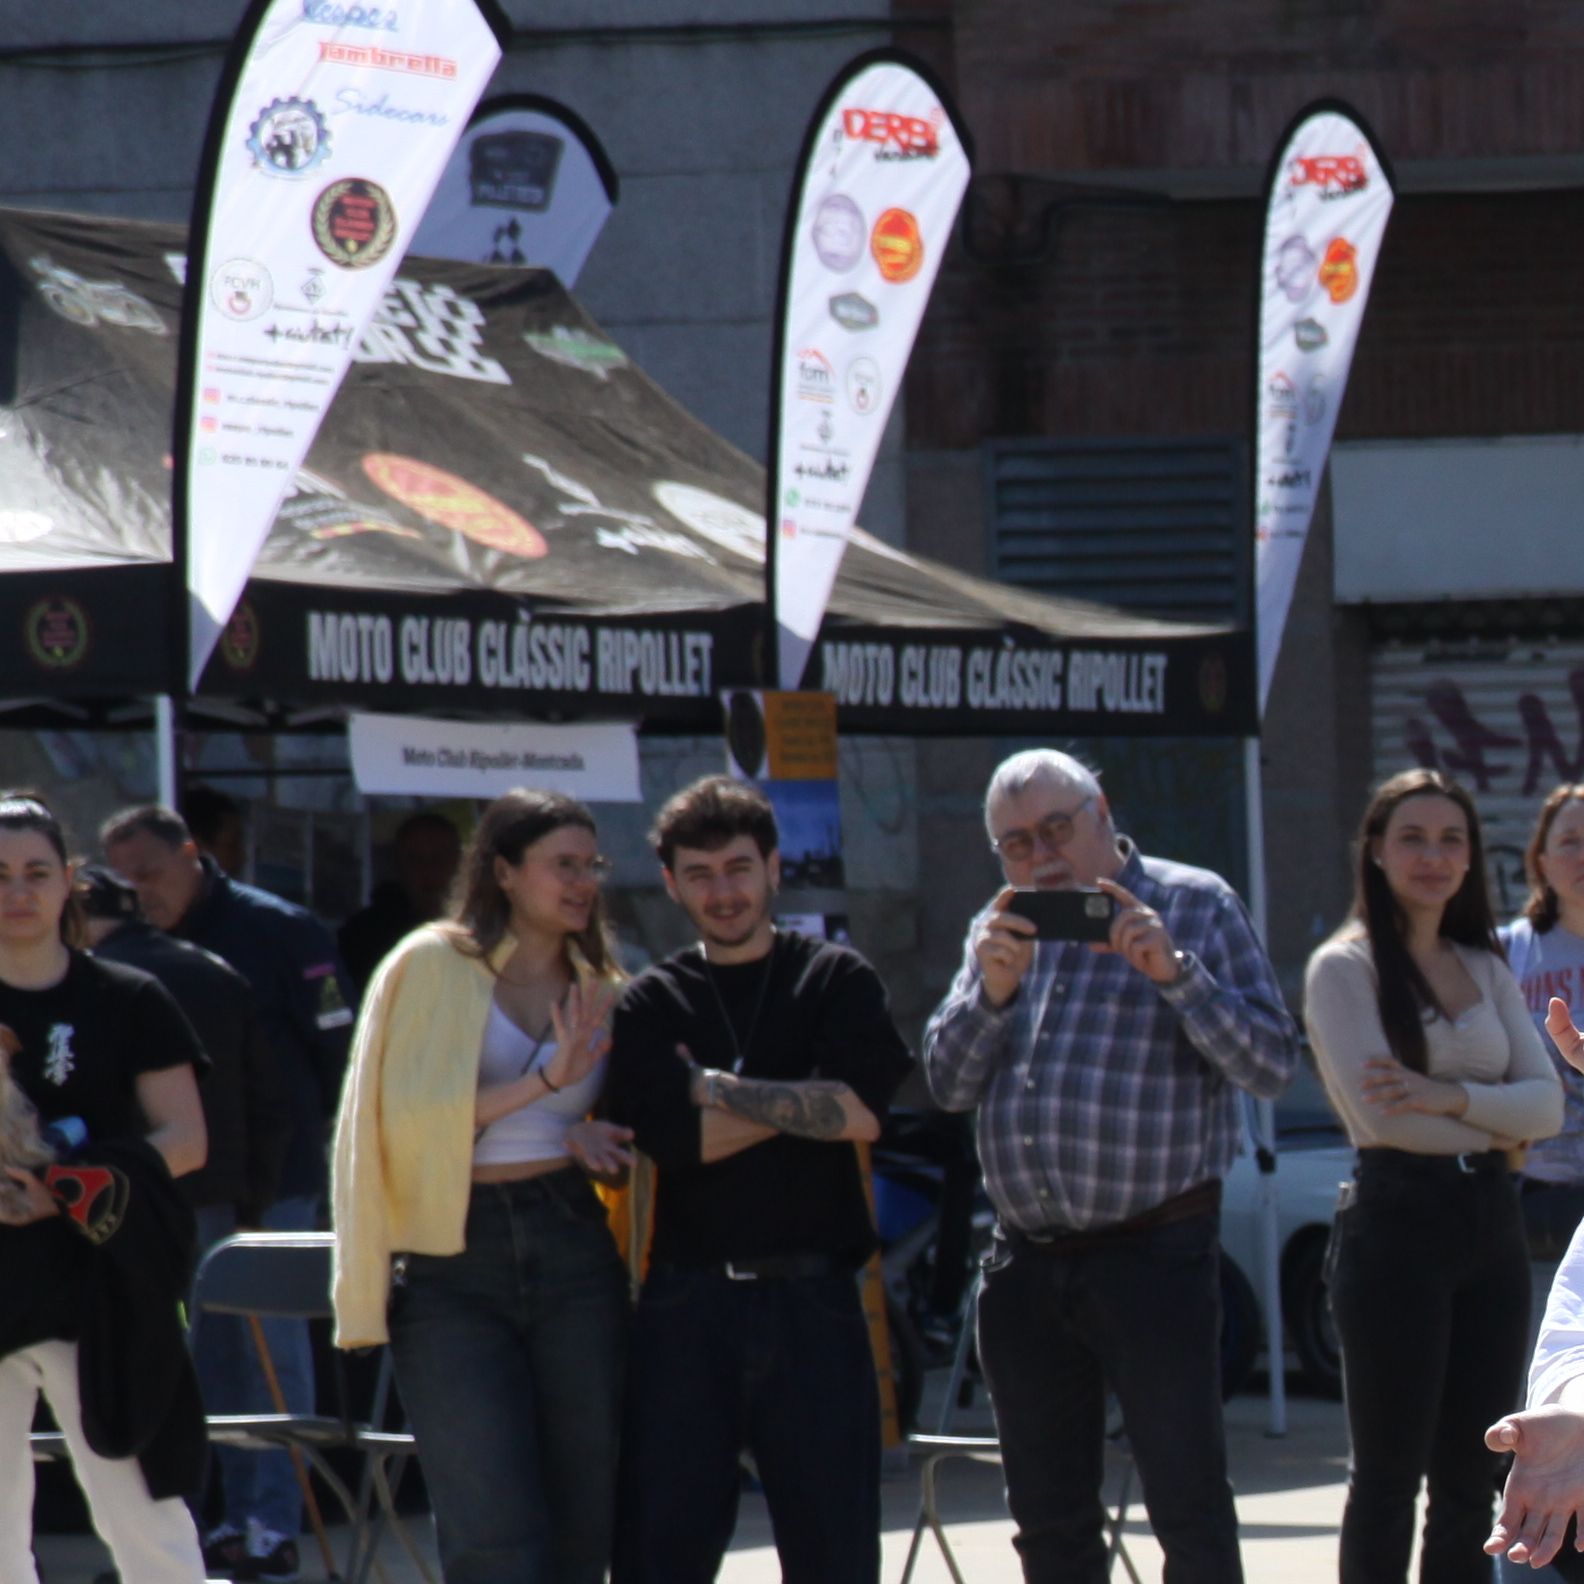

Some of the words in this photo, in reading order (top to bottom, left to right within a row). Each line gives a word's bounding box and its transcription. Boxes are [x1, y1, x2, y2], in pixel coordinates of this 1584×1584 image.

[307, 611, 393, 683] MOTO
[400, 616, 470, 685] CLUB
[598, 627, 714, 696] RIPOLLET
[821, 640, 895, 708] MOTO
[900, 643, 962, 709] CLUB
[1068, 651, 1168, 713] RIPOLLET
